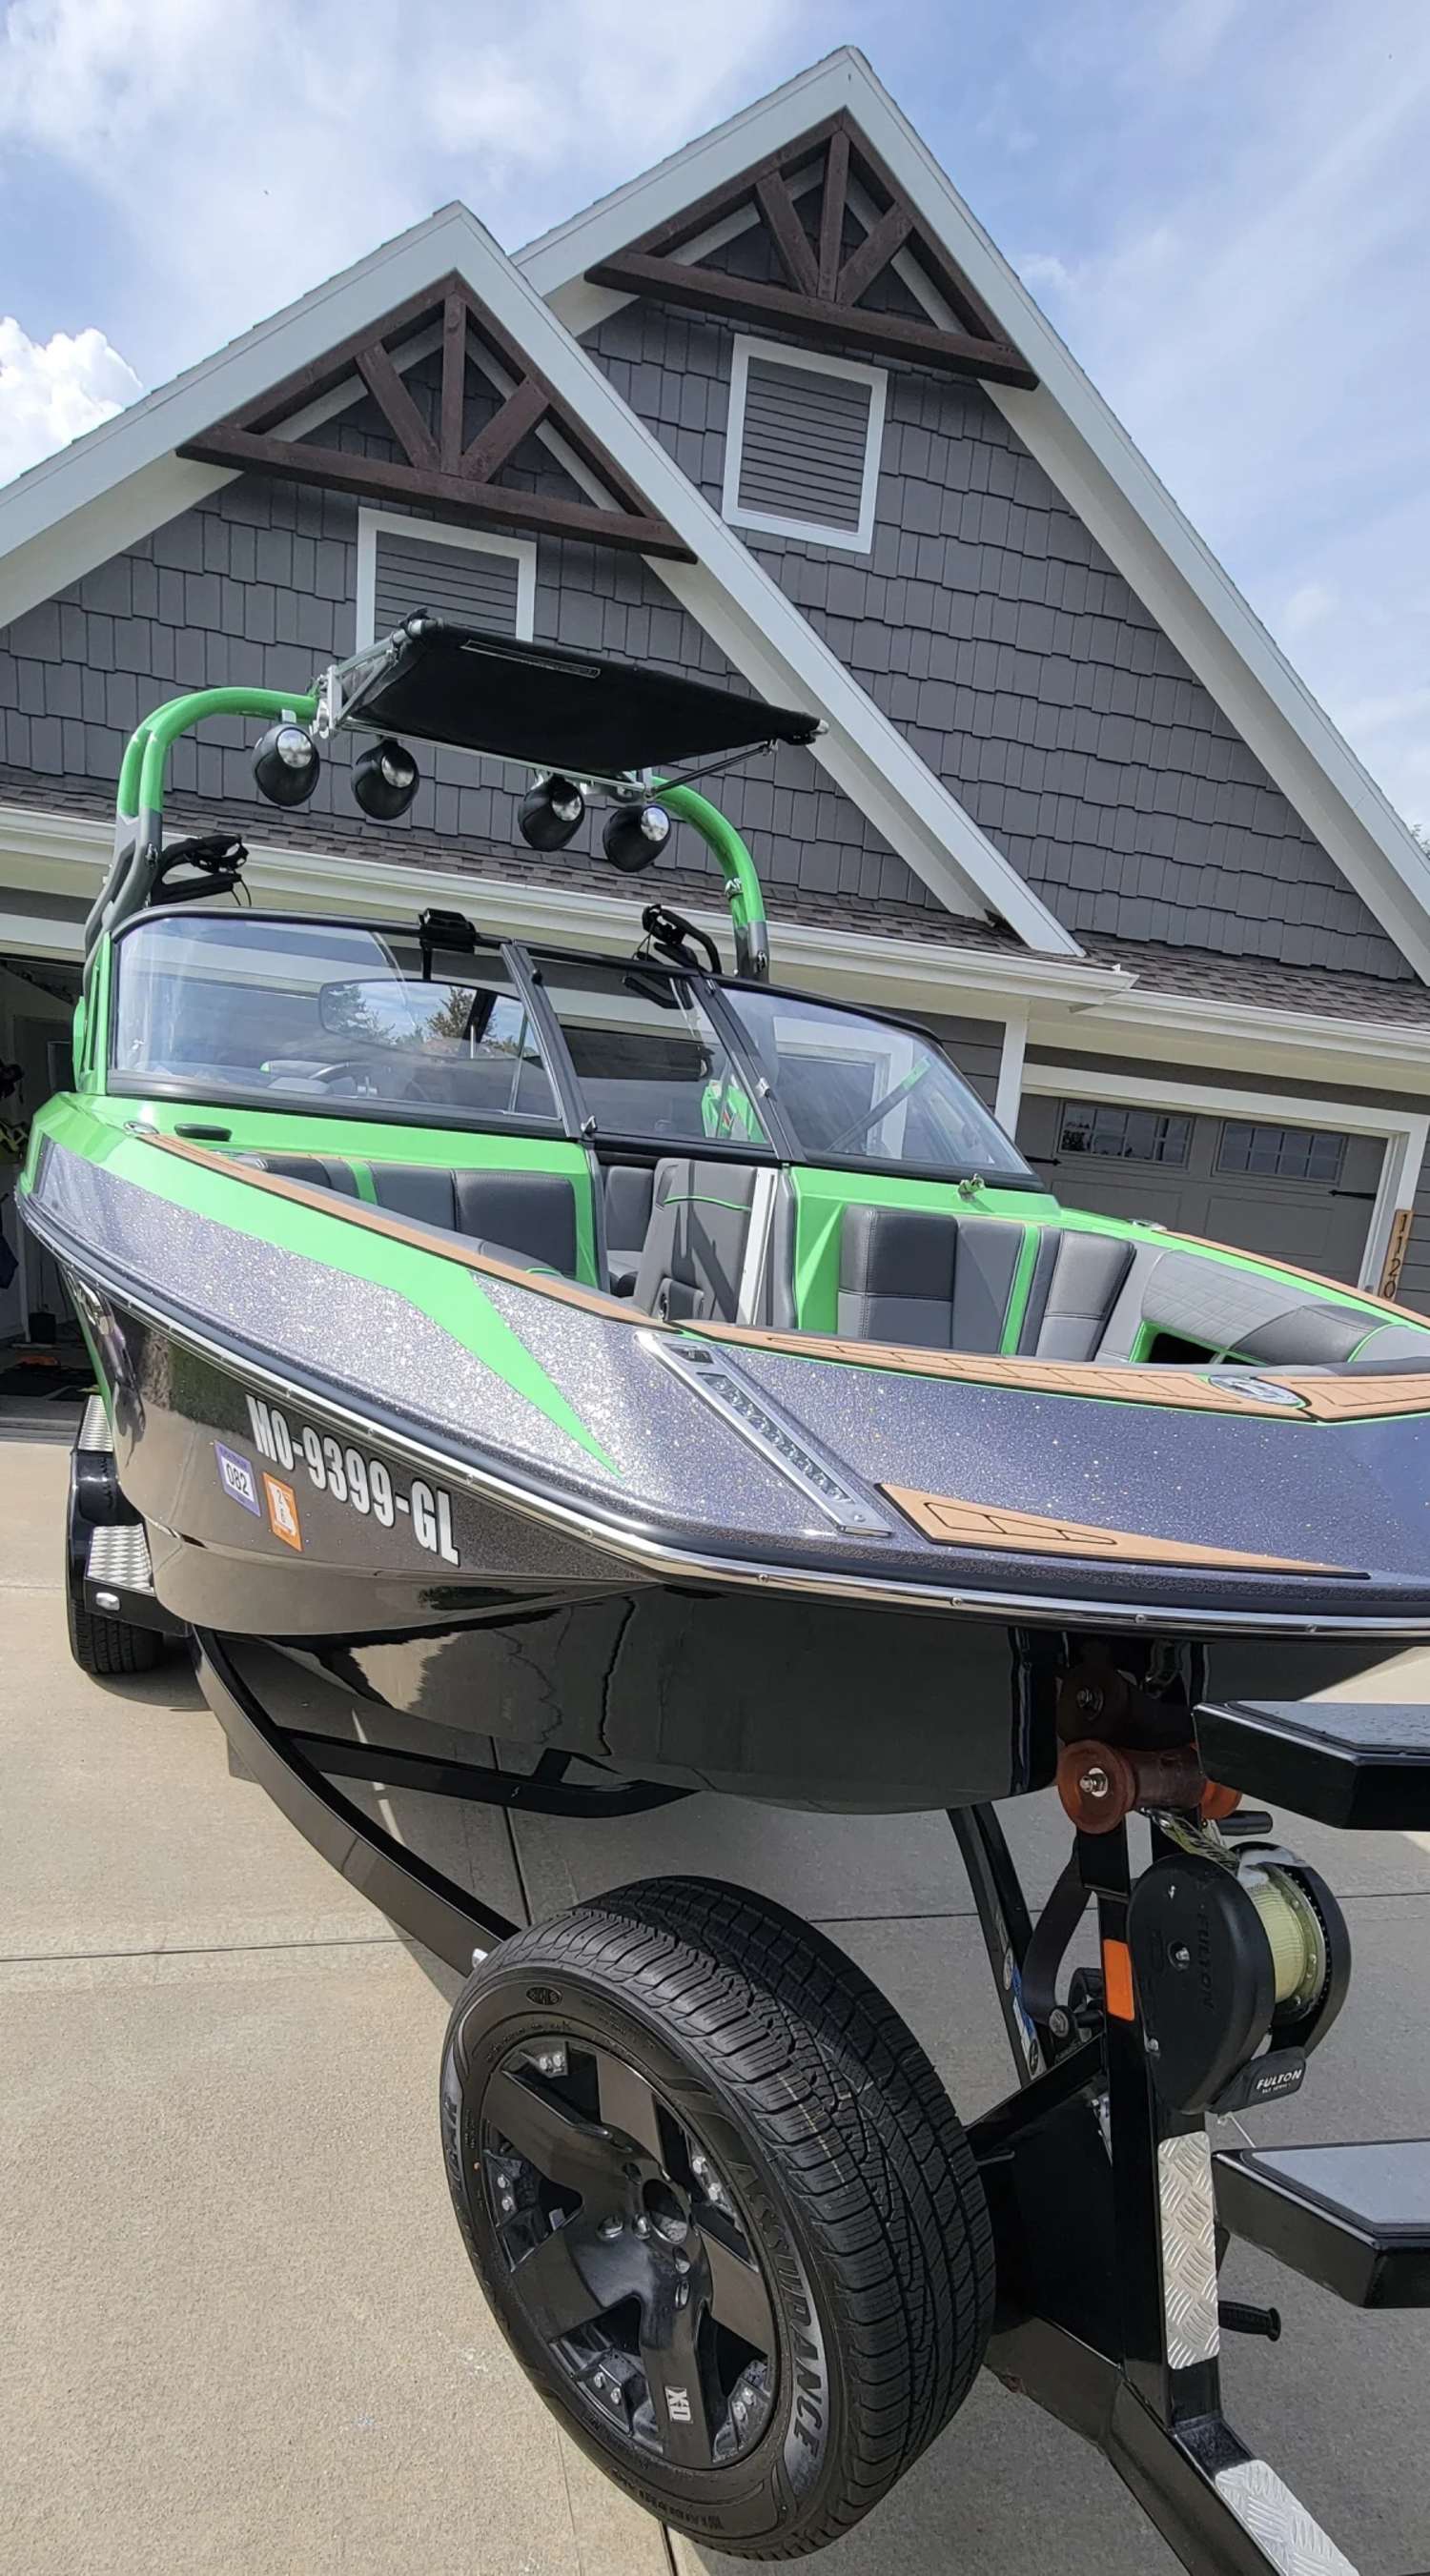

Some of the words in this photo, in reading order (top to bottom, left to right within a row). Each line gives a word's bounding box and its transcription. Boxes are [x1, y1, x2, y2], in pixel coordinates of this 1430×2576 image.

[1384, 1214, 1407, 1298] 1120
[226, 1463, 250, 1496] 082
[245, 1391, 460, 1568] MO-9399-GL
[1196, 1913, 1216, 2010] FULTON
[1256, 2069, 1302, 2090] FULTON
